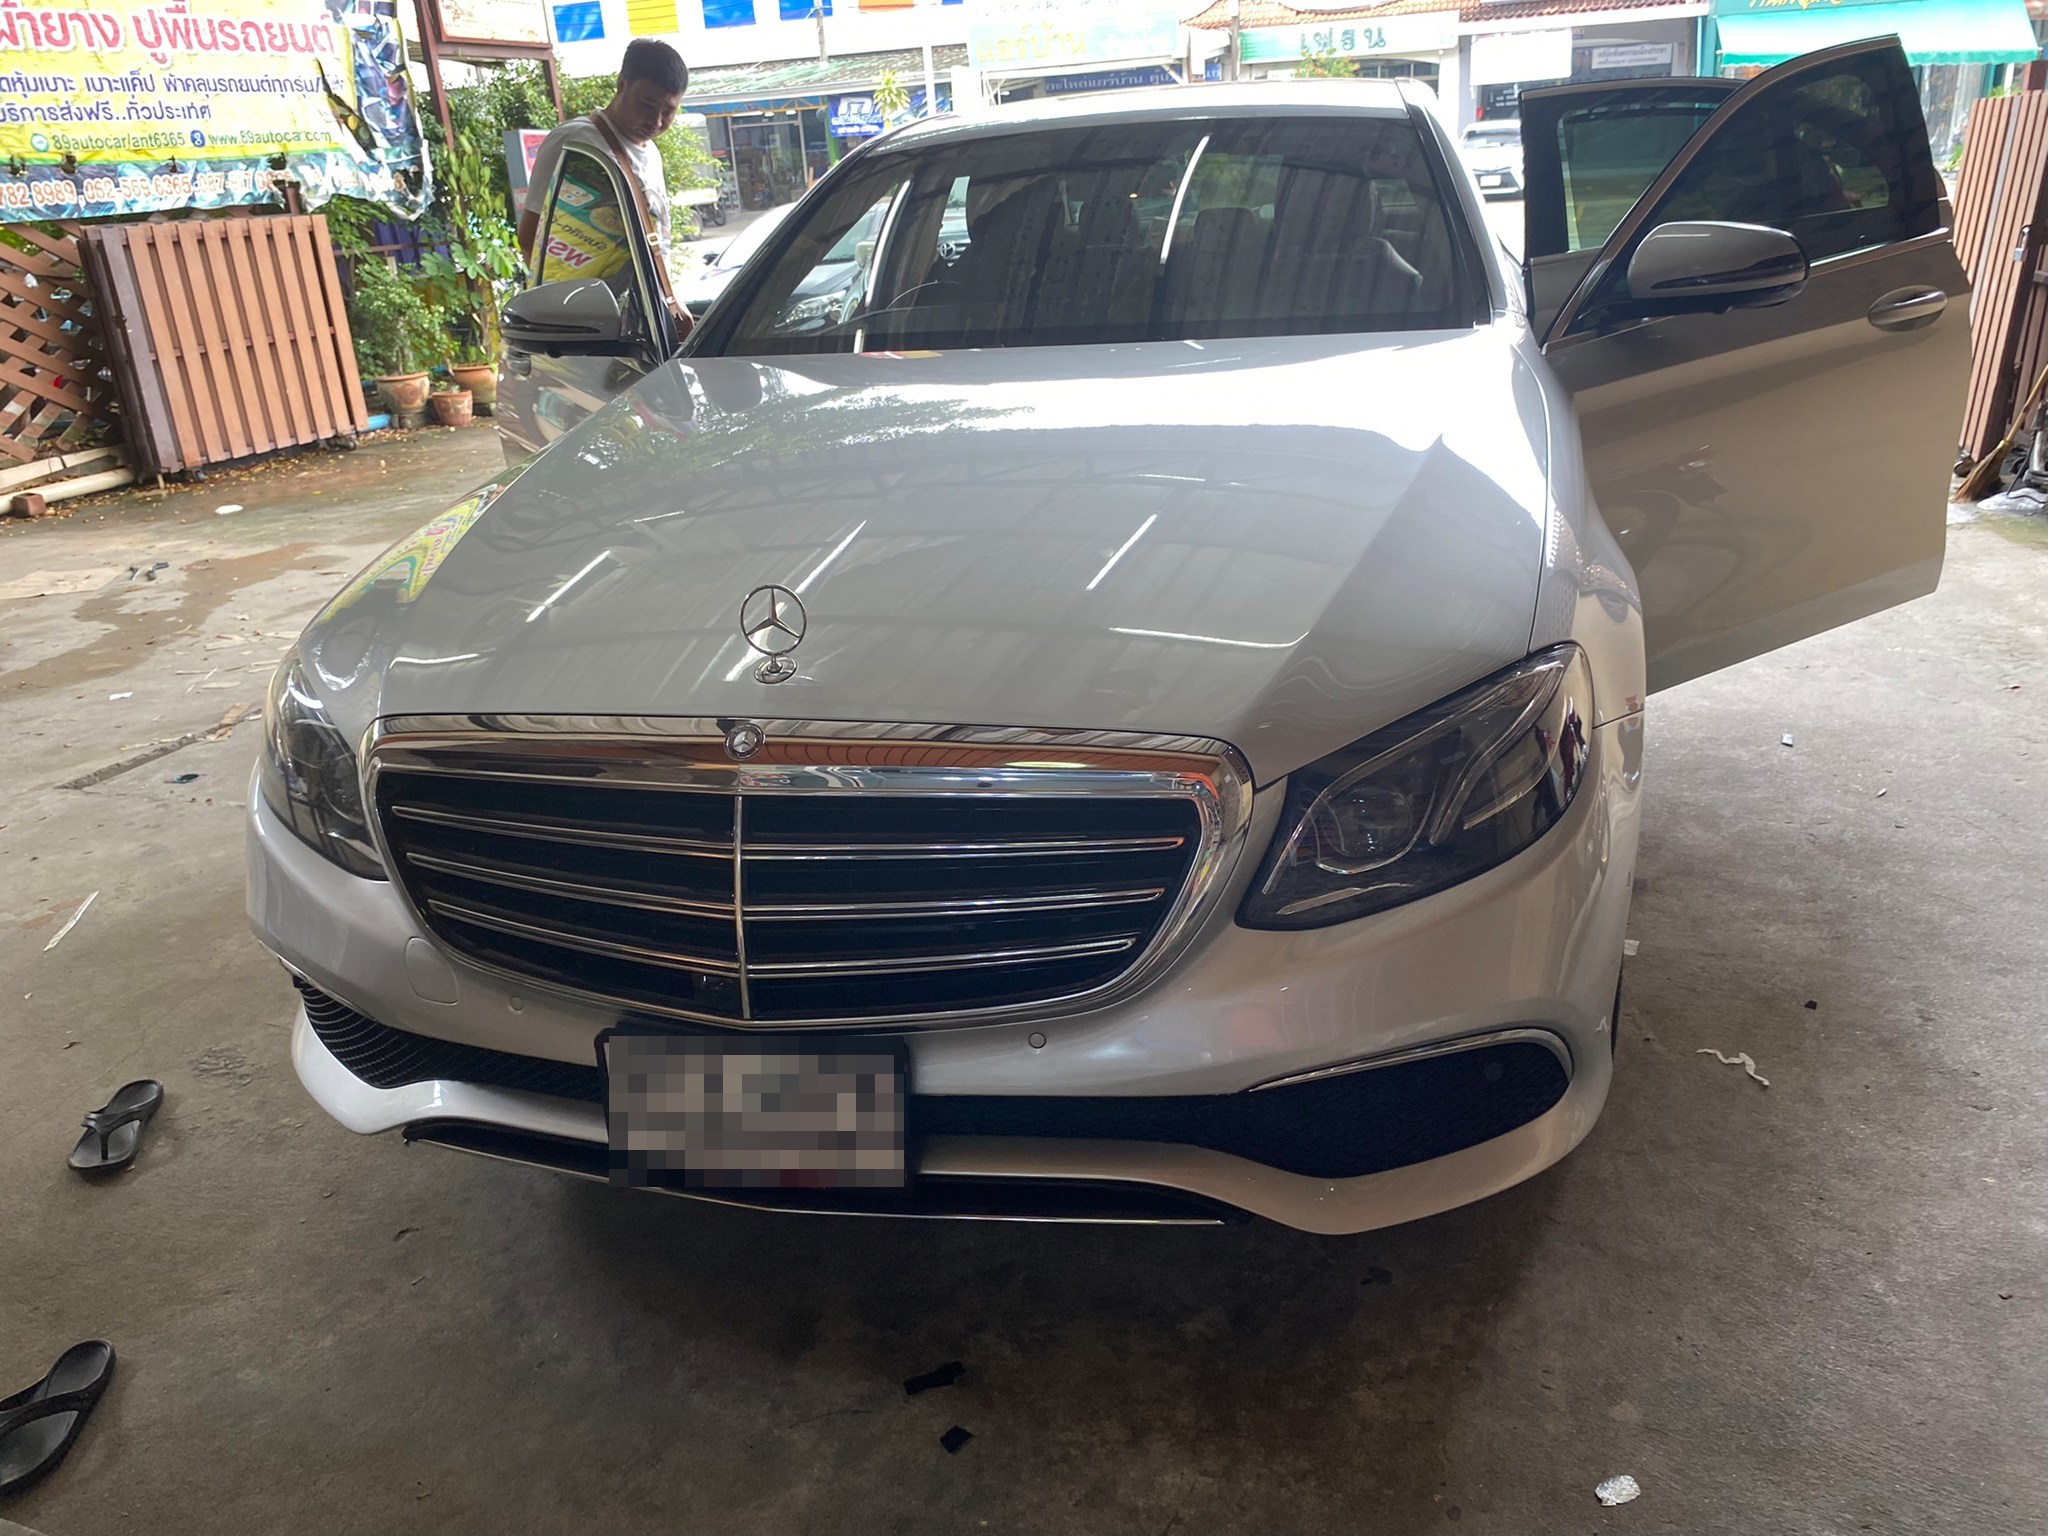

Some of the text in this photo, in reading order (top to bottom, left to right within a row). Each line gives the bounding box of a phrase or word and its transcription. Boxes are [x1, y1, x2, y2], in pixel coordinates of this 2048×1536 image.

[131, 0, 335, 64] ปูพืนรถยนต์
[208, 130, 331, 145] www.89autoca.com
